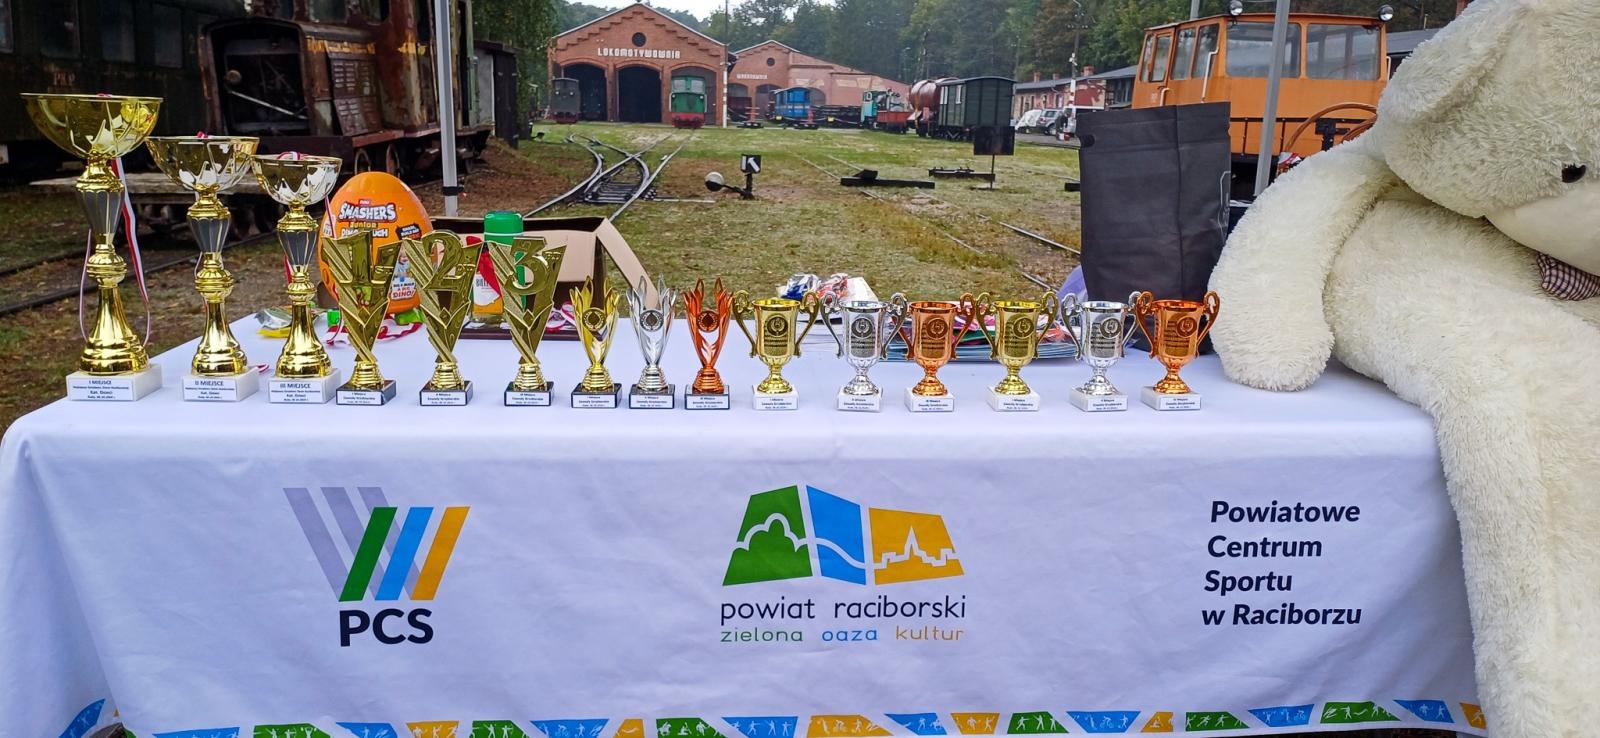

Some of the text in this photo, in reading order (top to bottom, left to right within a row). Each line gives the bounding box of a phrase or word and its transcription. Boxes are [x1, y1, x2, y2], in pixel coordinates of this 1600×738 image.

[598, 48, 680, 58] LOKOMOTYWOWNIA
[339, 203, 396, 220] SMASHERS
[505, 236, 548, 296] 3
[1210, 500, 1360, 522] Powiatowe
[1208, 535, 1322, 557] Centrum
[1204, 570, 1292, 596] Sportu
[720, 595, 966, 626] powiat raciborski
[1202, 602, 1362, 625] w Raciborzu
[340, 608, 434, 647] PCS
[720, 626, 964, 642] zielona oaza kultur
